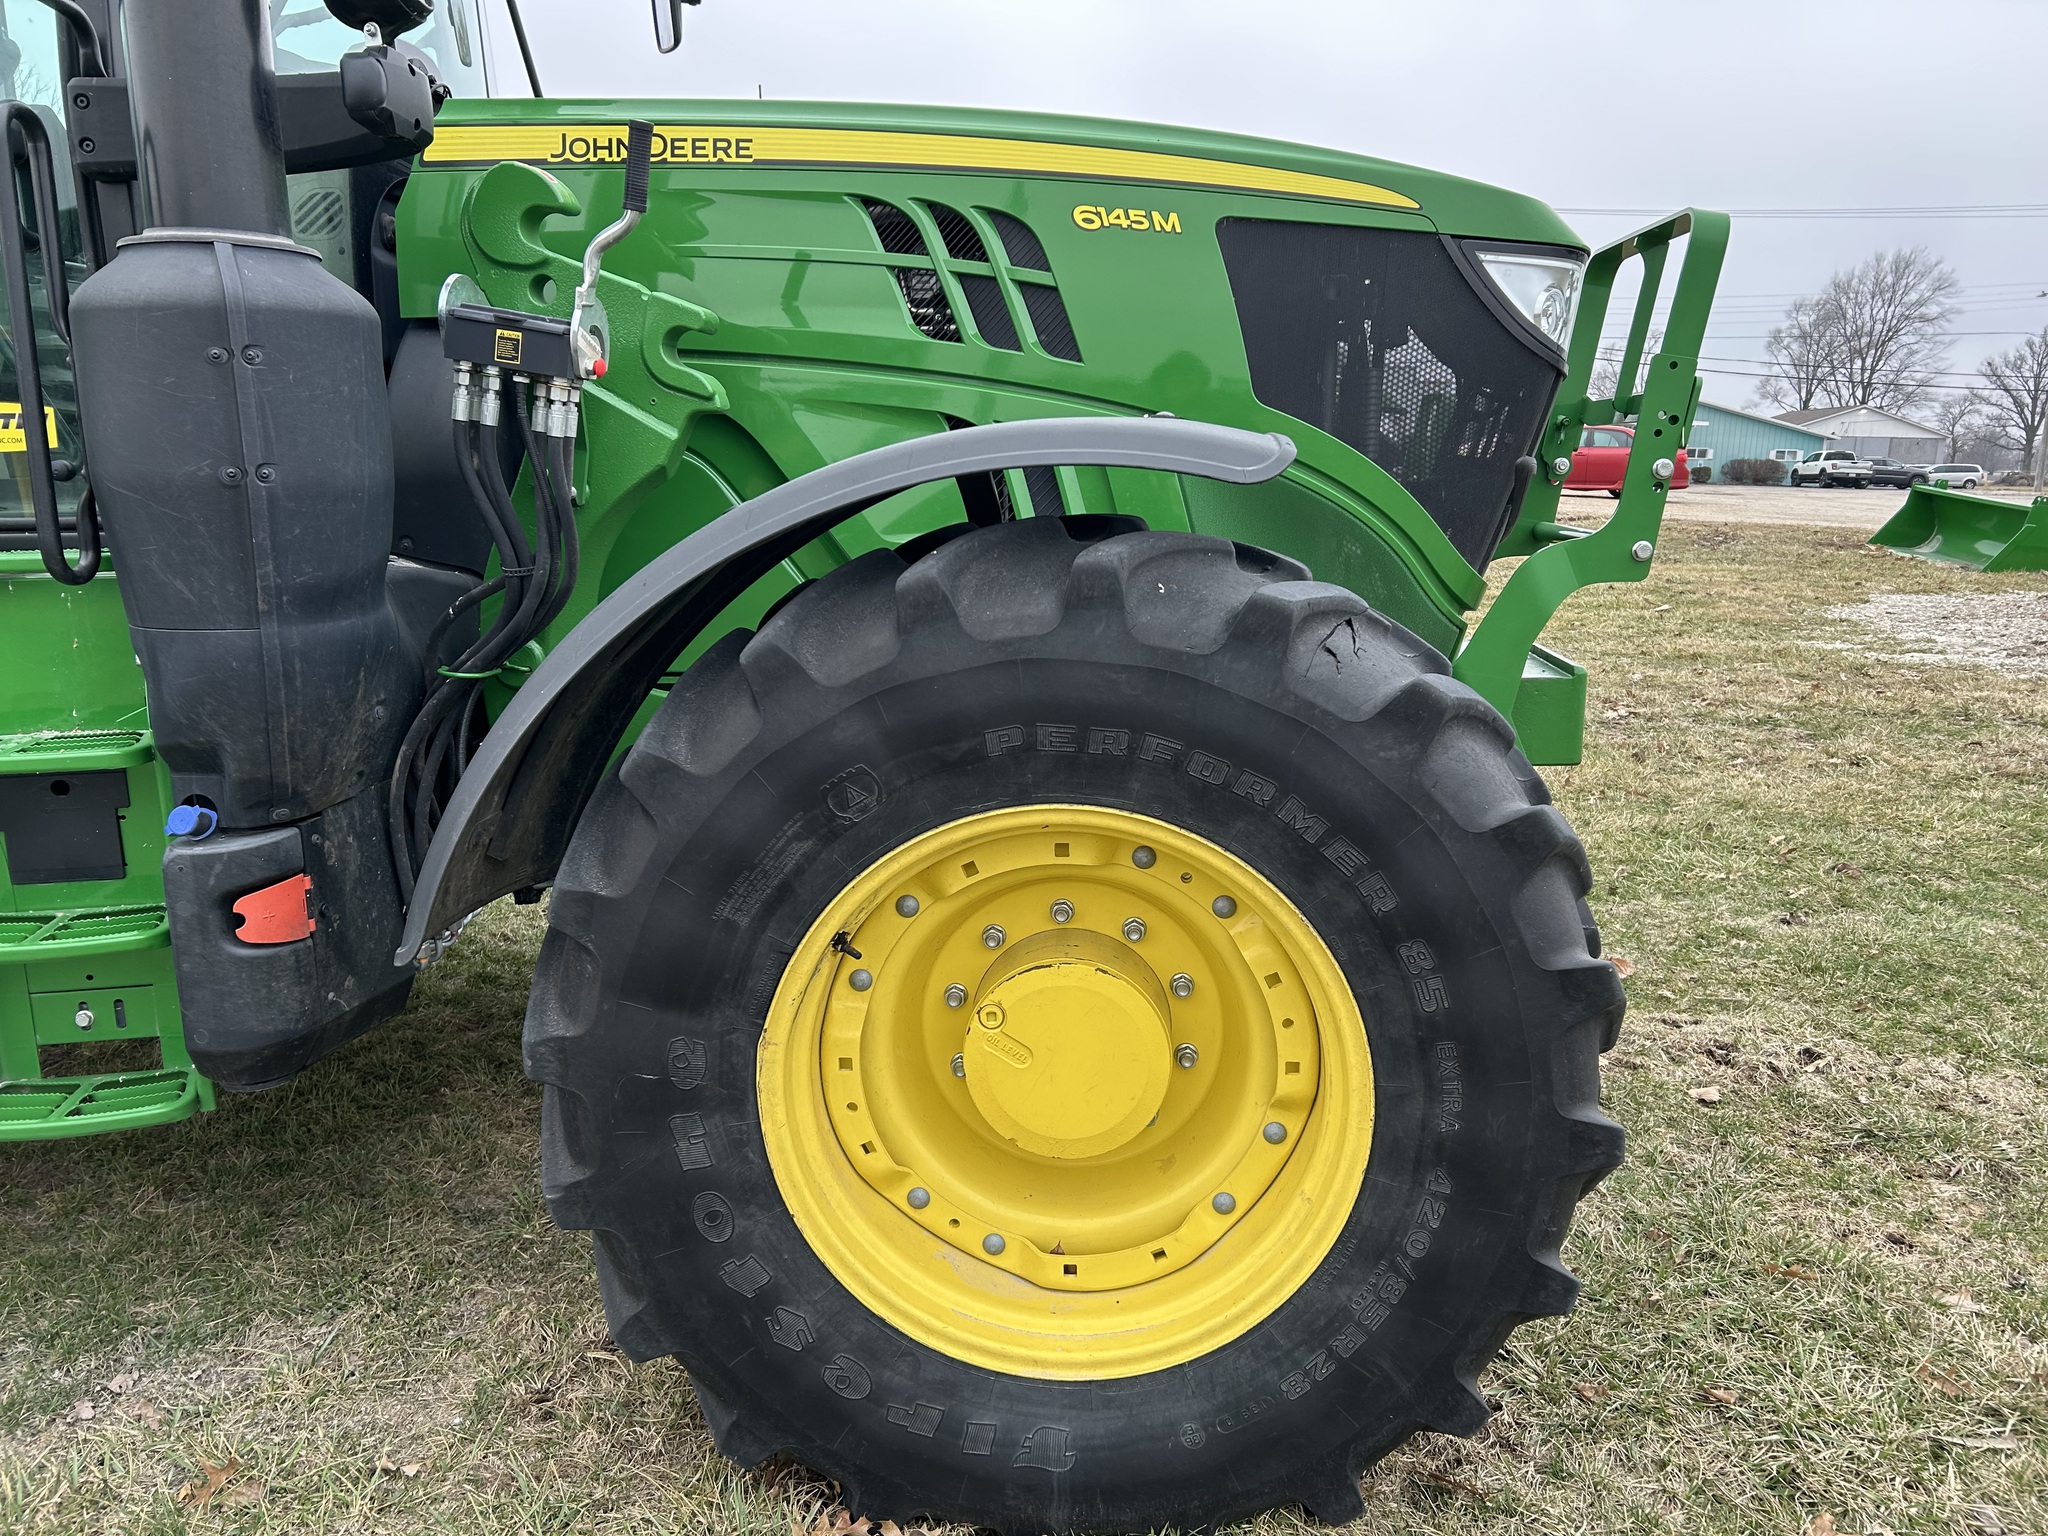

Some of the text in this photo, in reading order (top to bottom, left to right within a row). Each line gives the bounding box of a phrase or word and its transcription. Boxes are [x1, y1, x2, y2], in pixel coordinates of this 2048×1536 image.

[650, 133, 754, 159] DEERE
[983, 722, 1400, 918] PERFORMER
[1397, 938, 1451, 1014] 85
[1435, 1041, 1464, 1133] EXTRA
[986, 1034, 1027, 1064] OIL LEVEL
[1317, 1239, 1358, 1292] TUBELESS
[1184, 1433, 1204, 1447] 136
